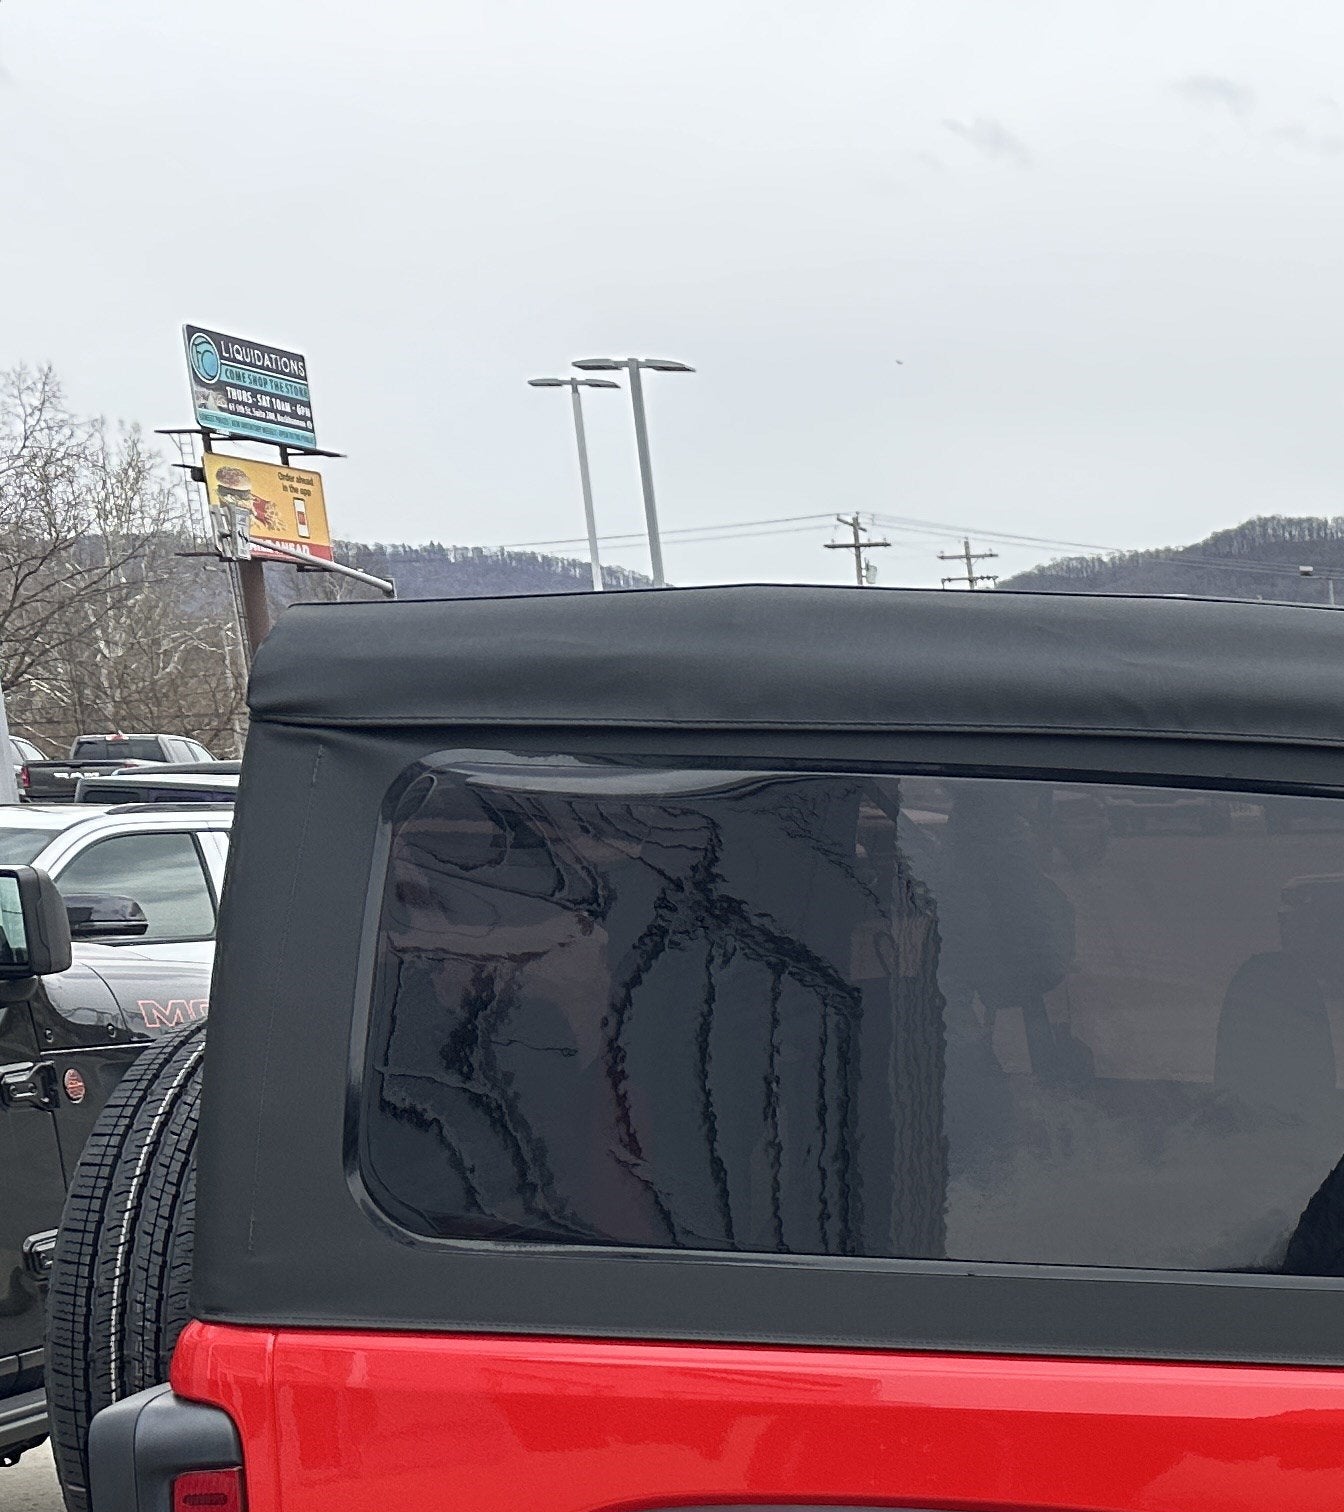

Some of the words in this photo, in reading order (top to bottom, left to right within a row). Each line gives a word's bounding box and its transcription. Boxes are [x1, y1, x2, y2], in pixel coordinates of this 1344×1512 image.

[221, 341, 305, 376] LIQUIDATIONS
[226, 386, 252, 404] THURS
[256, 393, 270, 408] SAT
